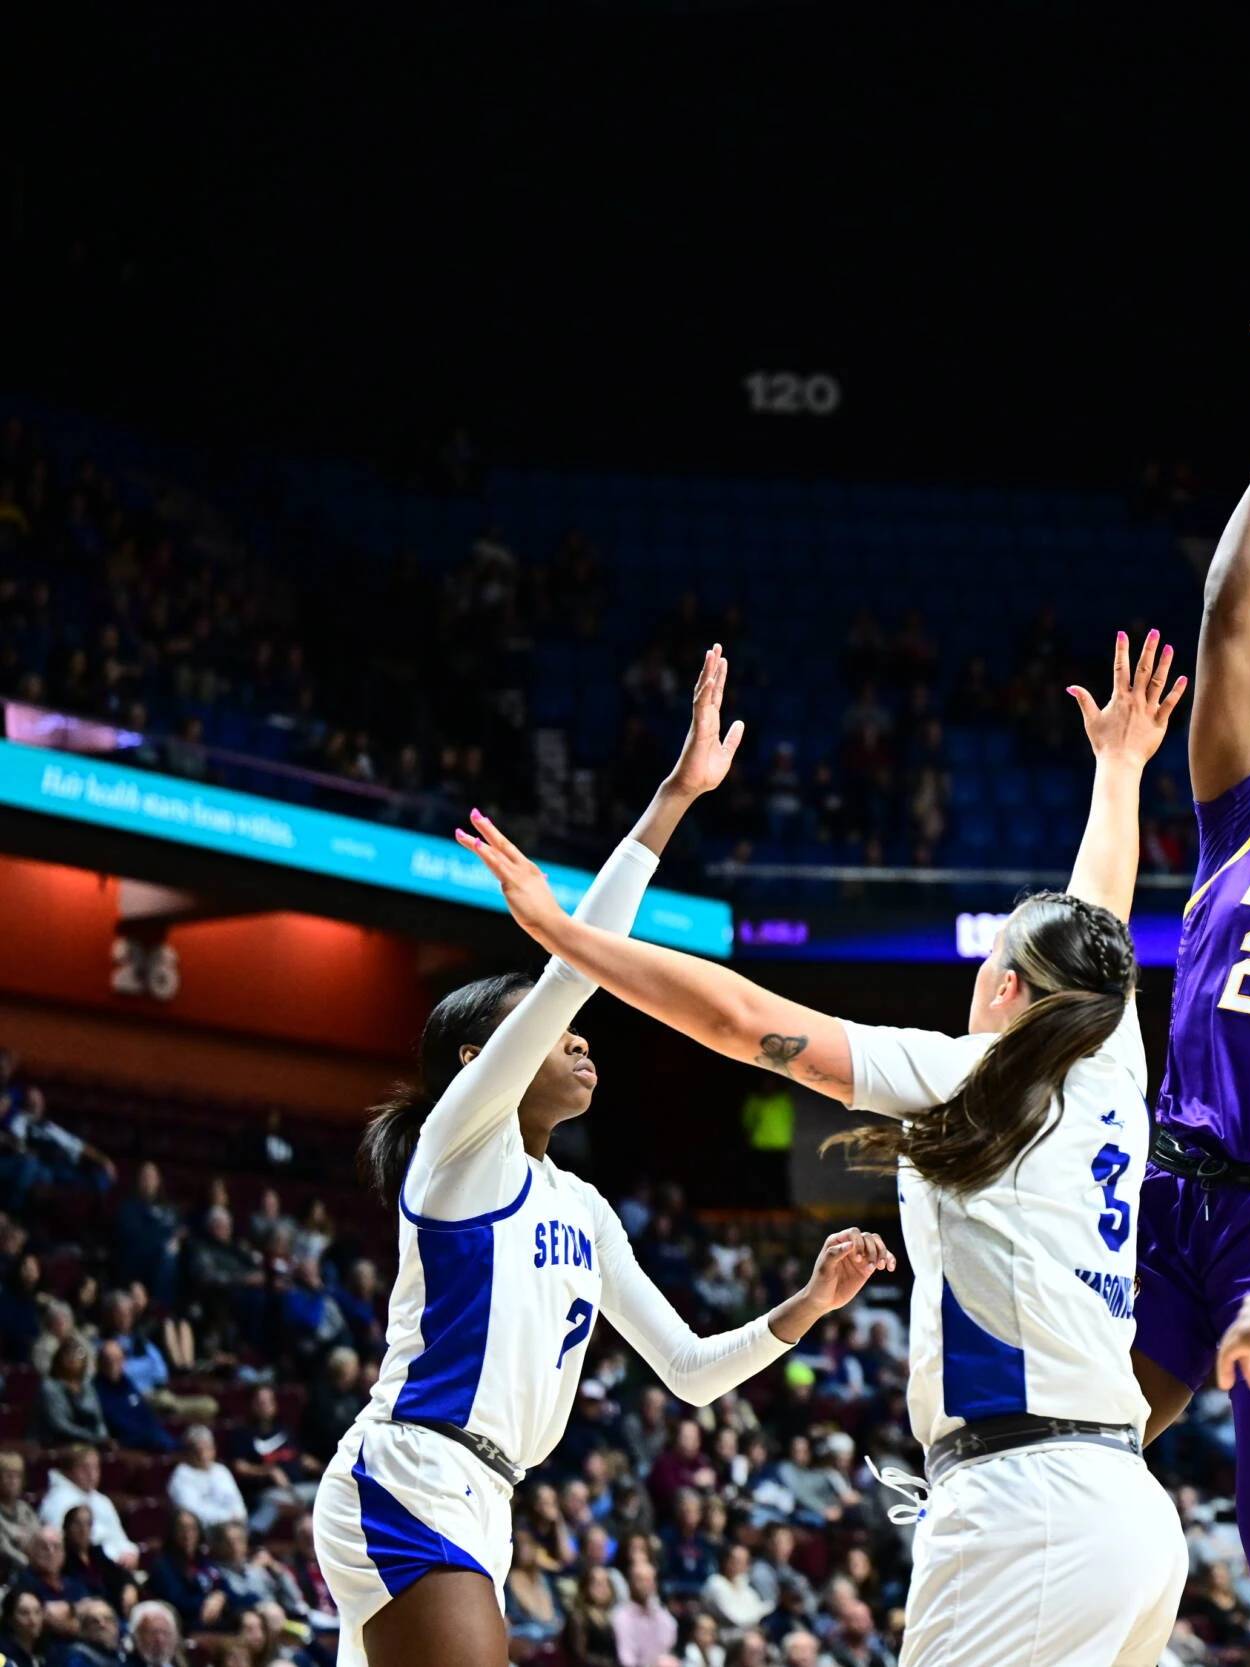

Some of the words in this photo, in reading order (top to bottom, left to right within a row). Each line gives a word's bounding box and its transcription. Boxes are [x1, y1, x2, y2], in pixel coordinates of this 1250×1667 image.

[745, 372, 841, 415] 120
[1091, 1142, 1131, 1253] 3
[534, 1219, 592, 1271] SETON
